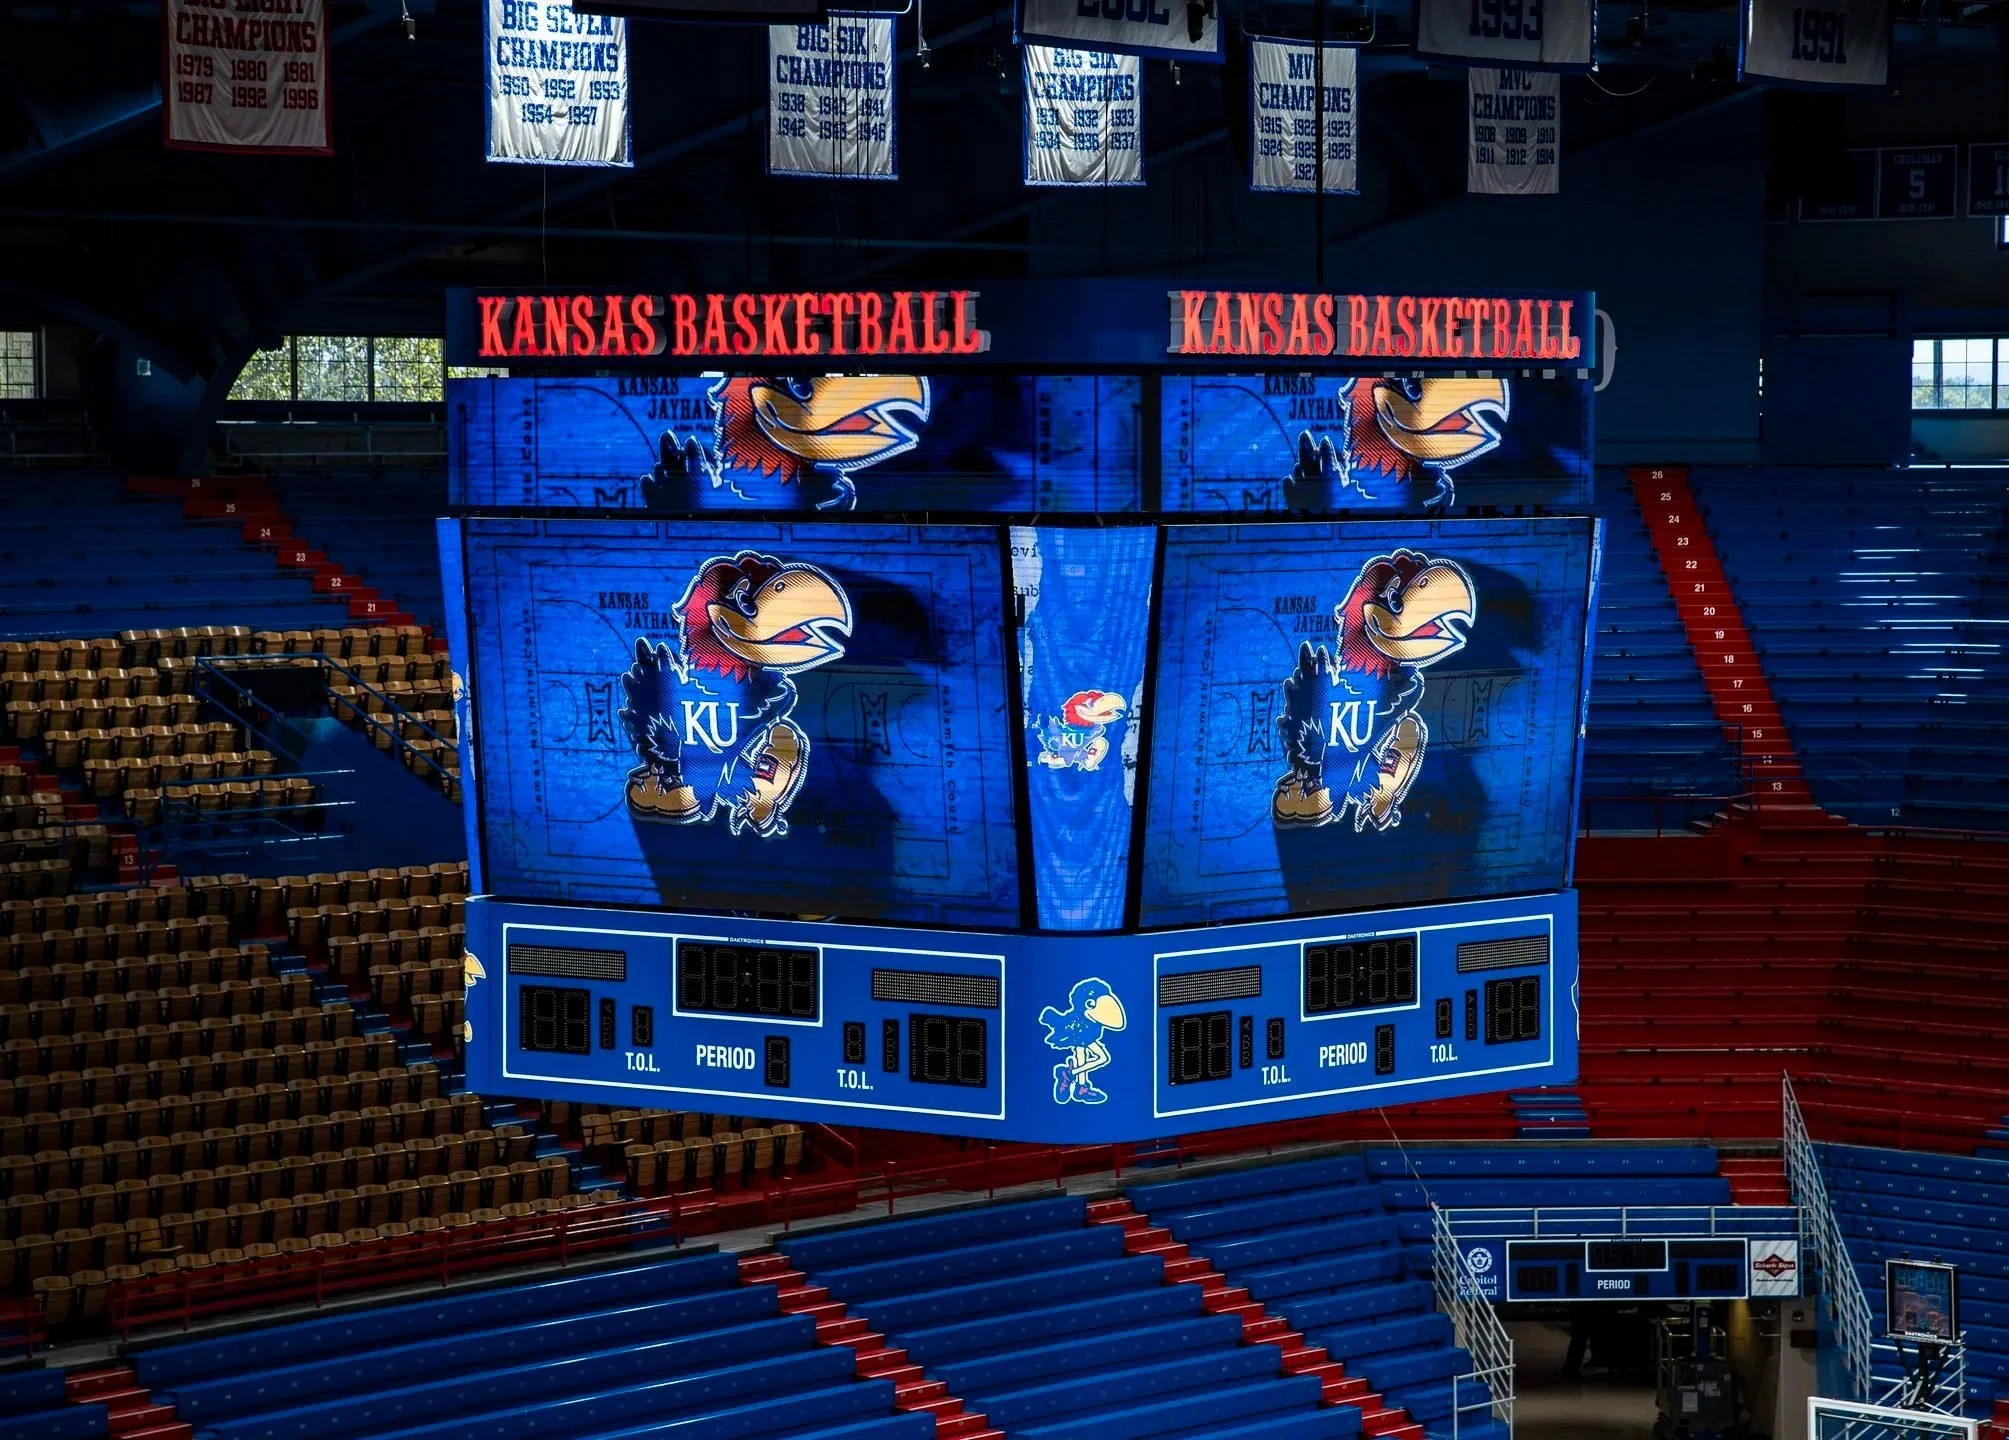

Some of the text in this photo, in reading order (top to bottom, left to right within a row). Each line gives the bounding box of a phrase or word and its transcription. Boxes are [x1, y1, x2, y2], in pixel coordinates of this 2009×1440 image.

[503, 0, 613, 35] BIG SEVEN
[1469, 0, 1543, 40] 1993
[177, 12, 316, 52] CHAMPIONS
[797, 24, 866, 55] BIG SIX
[1792, 8, 1846, 63] 1991
[497, 36, 618, 72] CHAMPIONS
[1054, 48, 1118, 69] BIG SIX
[177, 54, 315, 82] 1979 1980 1981
[777, 55, 886, 90] CHAMPIONS
[1288, 53, 1317, 80] MV
[500, 75, 619, 100] 1950 1952 1953
[1035, 71, 1135, 101] CHAMPIONS
[1499, 69, 1531, 90] MVC
[178, 82, 318, 109] 1987 1992 1996
[1260, 83, 1351, 113] CHAMPONS
[522, 103, 597, 125] 1954 1957
[820, 96, 847, 116] 1940
[861, 98, 885, 117] 1941
[1473, 93, 1555, 120] CHAMPIONS
[1036, 107, 1134, 128] 1931 1932 1933
[1260, 117, 1282, 135] 1915
[1328, 121, 1351, 138] 1923
[778, 117, 805, 138] 1942
[860, 122, 886, 141] 1946
[1475, 125, 1555, 144] 1908 1909 1910
[1035, 132, 1135, 151] 1934 1936 1937
[1260, 139, 1282, 157] 1924
[1328, 143, 1351, 160] 1926
[1476, 147, 1555, 165] 1911 1912 1914
[1295, 164, 1317, 181] 1927
[1907, 168, 1926, 199] 5
[477, 290, 985, 357] KANSAS BASKETBALL
[1176, 289, 1580, 359] KANSAS BASKETBALL
[617, 377, 679, 396] KANSAS
[1264, 377, 1315, 396] KANSAS
[1652, 470, 1663, 480] 26
[1660, 492, 1672, 501] 25
[226, 504, 236, 513] 25
[1668, 514, 1680, 523] 24
[261, 528, 271, 537] 24
[1677, 537, 1689, 546] 23
[296, 553, 306, 562] 23
[1685, 561, 1697, 569] 22
[331, 577, 341, 587] 22
[1694, 584, 1705, 592] 21
[367, 602, 376, 612] 21
[598, 592, 649, 609] KANSAS
[1273, 596, 1317, 614] KANSAS
[1703, 607, 1715, 616] 20
[1714, 630, 1725, 640] 19
[1723, 655, 1734, 664] 18
[1732, 680, 1743, 688] 17
[1742, 704, 1752, 713] 16
[680, 701, 739, 753] KU
[1327, 700, 1378, 752] KU
[1752, 729, 1762, 739] 15
[1061, 732, 1085, 749] KU
[1772, 782, 1782, 791] 13
[1890, 808, 1900, 816] 12
[124, 854, 134, 865] 13
[625, 1051, 660, 1073] T.O.L.
[696, 1044, 756, 1070] PERIOD
[1319, 1041, 1367, 1068] PERIOD
[1429, 1043, 1458, 1063] T.O.L.
[837, 1068, 874, 1090] T.O.L.
[1261, 1064, 1292, 1085] T.O.L.
[1597, 1279, 1631, 1290] PERIOD
